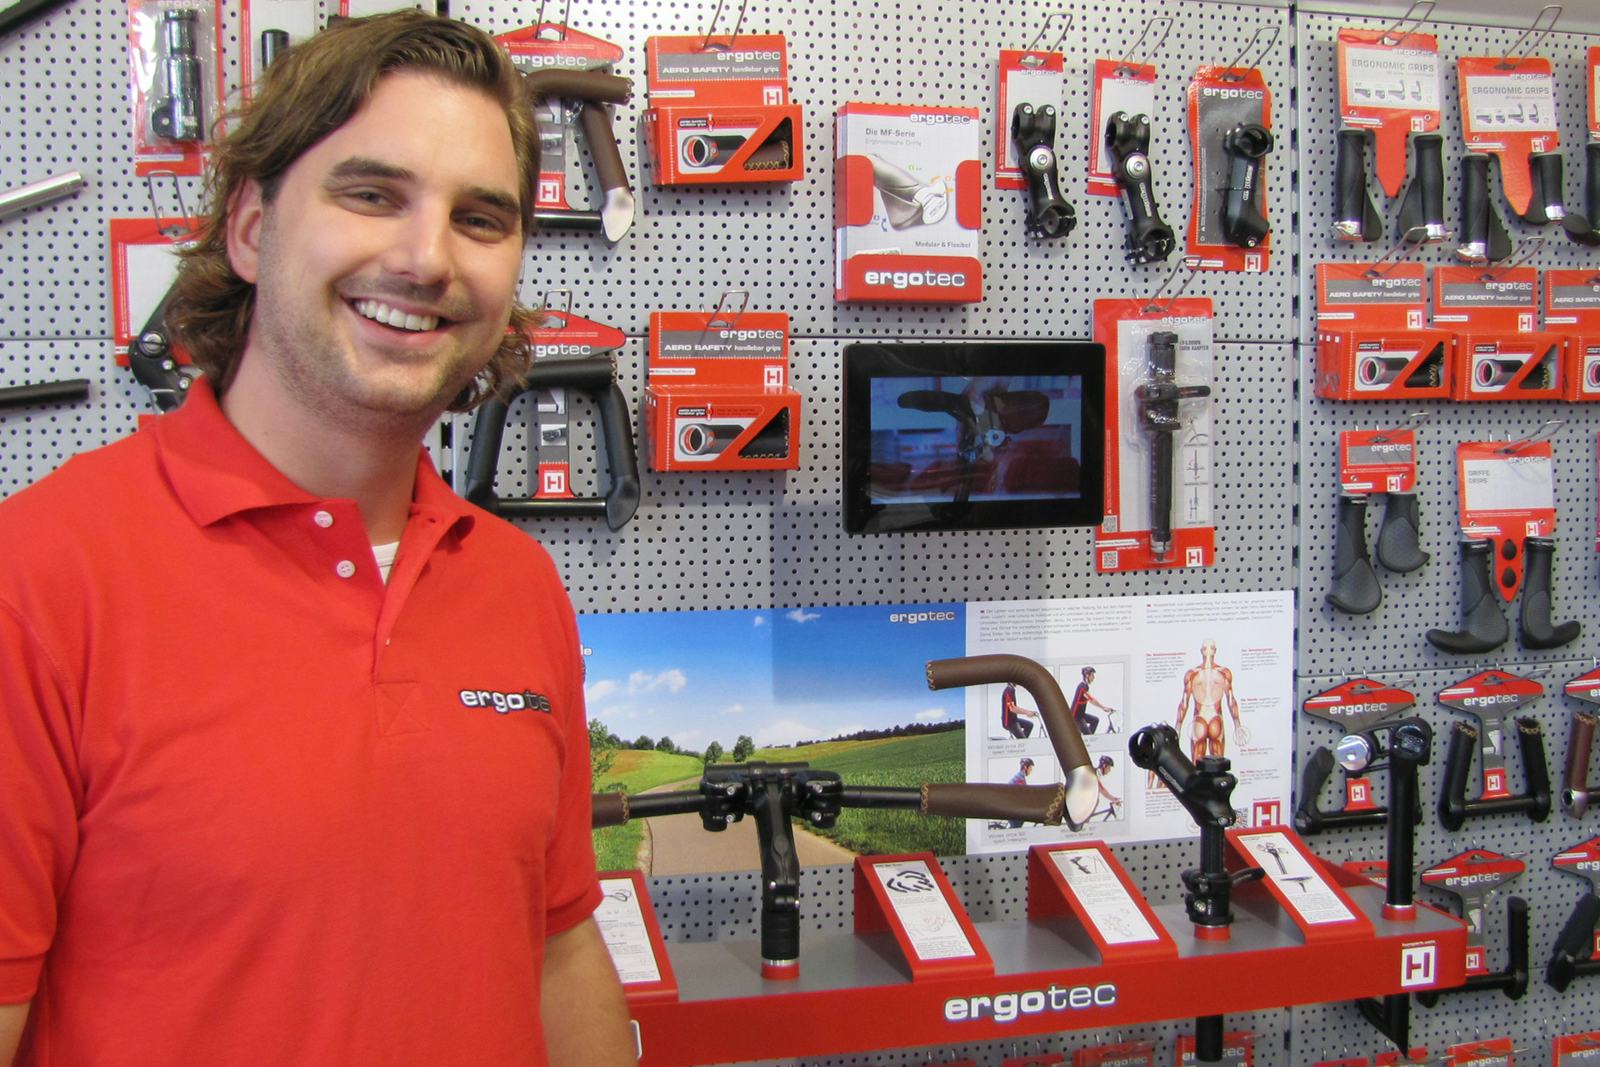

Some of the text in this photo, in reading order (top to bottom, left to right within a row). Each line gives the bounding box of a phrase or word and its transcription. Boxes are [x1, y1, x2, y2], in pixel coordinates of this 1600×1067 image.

[511, 54, 588, 68] ergotec
[716, 50, 781, 62] ergotec
[692, 66, 730, 74] SAFETY
[1351, 59, 1434, 72] ERGONOMIC GRIPS
[1203, 87, 1264, 100] ergotec
[1472, 86, 1550, 95] ERGONOMIC GRIPS
[910, 113, 970, 125] ergotec
[865, 128, 916, 138] Die MF-Serie
[865, 270, 966, 289] ergotec
[1372, 278, 1421, 289] ergotec
[1485, 282, 1533, 292] ergotec
[720, 330, 784, 341] ergotec
[522, 344, 592, 358] gotec
[1370, 444, 1412, 454] ergotec
[889, 611, 955, 624] ergotec
[1463, 693, 1518, 707] ergotec
[1329, 702, 1388, 716] ergotec
[1445, 872, 1500, 887] ergotec
[1404, 950, 1432, 981] H
[944, 984, 1117, 1022] ergotec
[1182, 1047, 1246, 1061] erec
